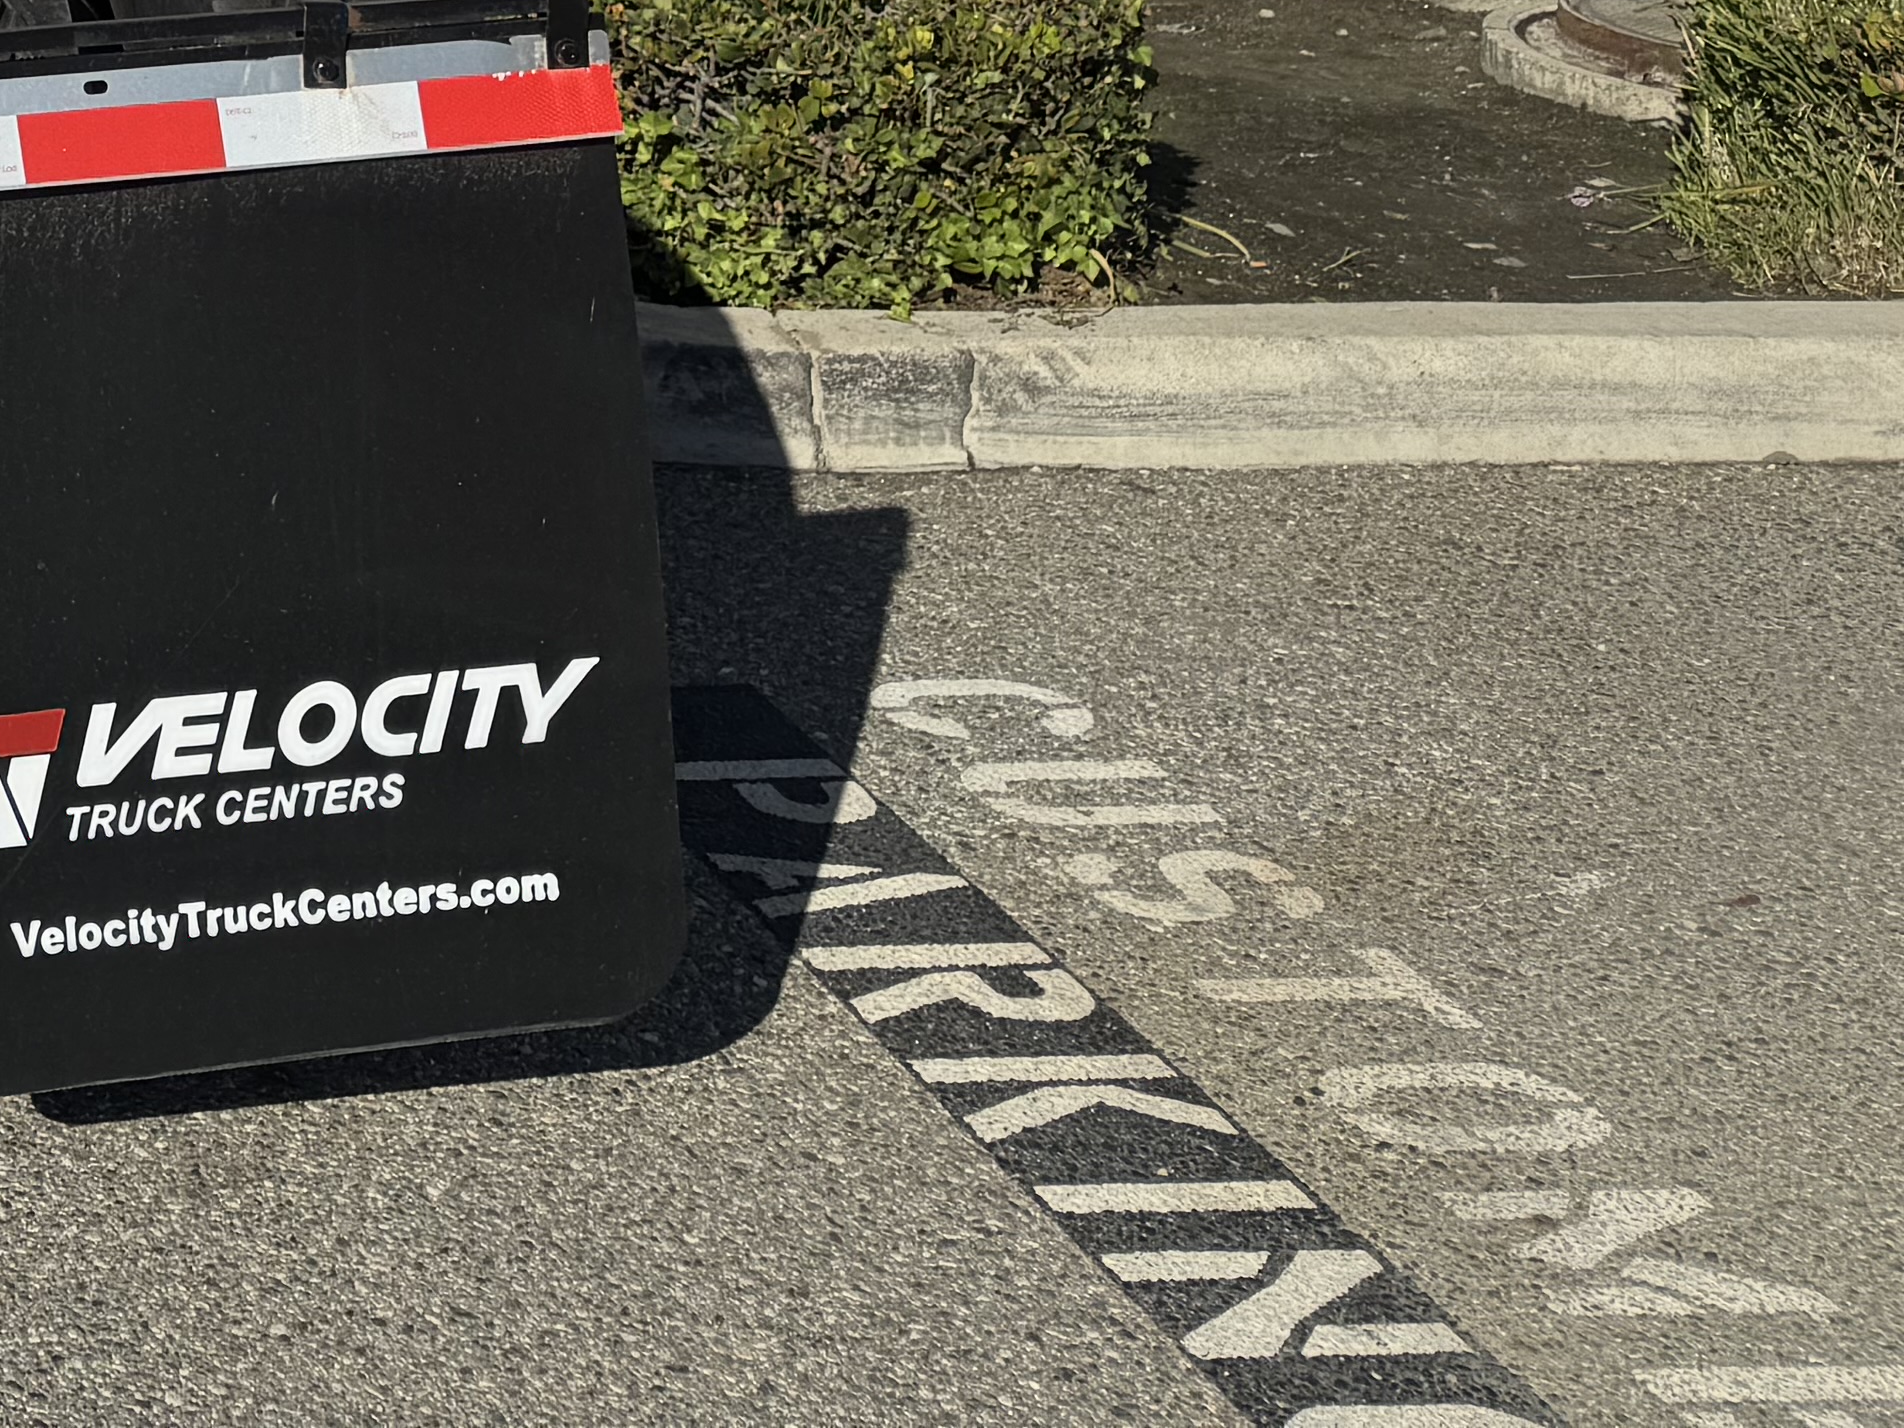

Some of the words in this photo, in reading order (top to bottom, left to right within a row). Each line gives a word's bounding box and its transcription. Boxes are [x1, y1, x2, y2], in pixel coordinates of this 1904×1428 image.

[76, 656, 601, 788] VELOCITY
[65, 791, 206, 843] TRUCK
[214, 772, 407, 826] CENTERS
[9, 870, 562, 959] VelocityTruckCenters.com
[674, 757, 1547, 1428] PARKIN
